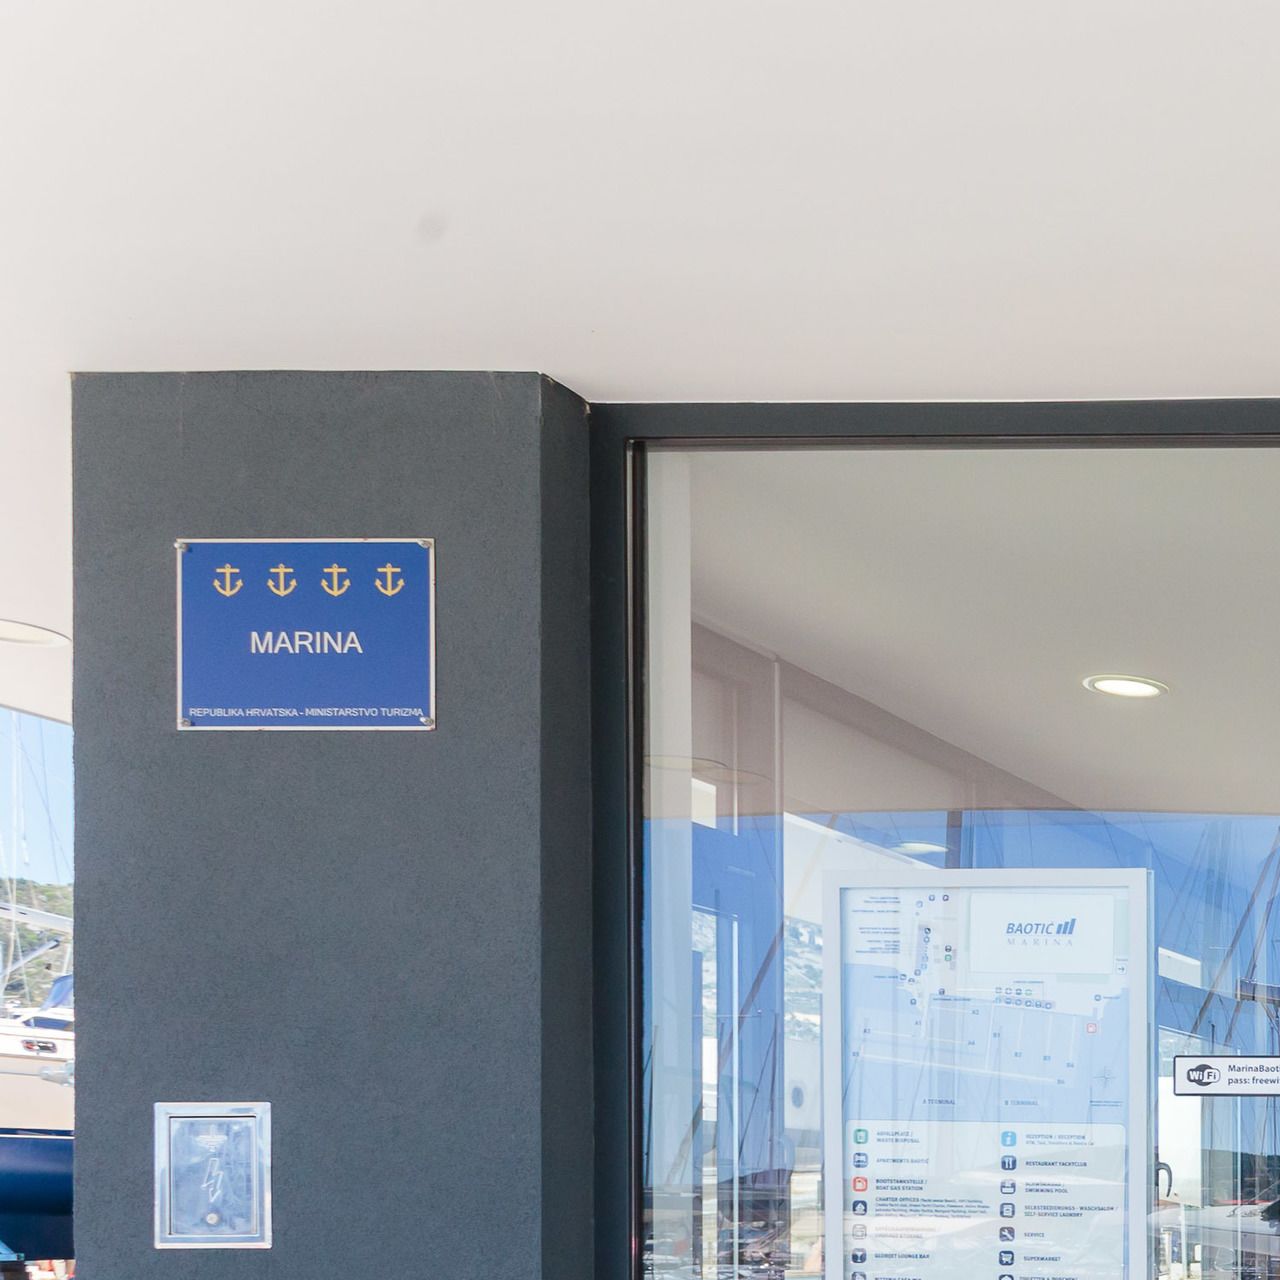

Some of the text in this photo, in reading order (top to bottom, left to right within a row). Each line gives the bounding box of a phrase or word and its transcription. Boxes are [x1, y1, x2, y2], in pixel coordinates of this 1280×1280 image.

[250, 631, 363, 654] MARINA
[189, 707, 245, 718] REPUBLIKA
[246, 707, 298, 718] HRVATSKA
[305, 707, 379, 718] MINISTARSTVO
[381, 707, 424, 718] TURIZMA
[1227, 1077, 1250, 1086] pass:
